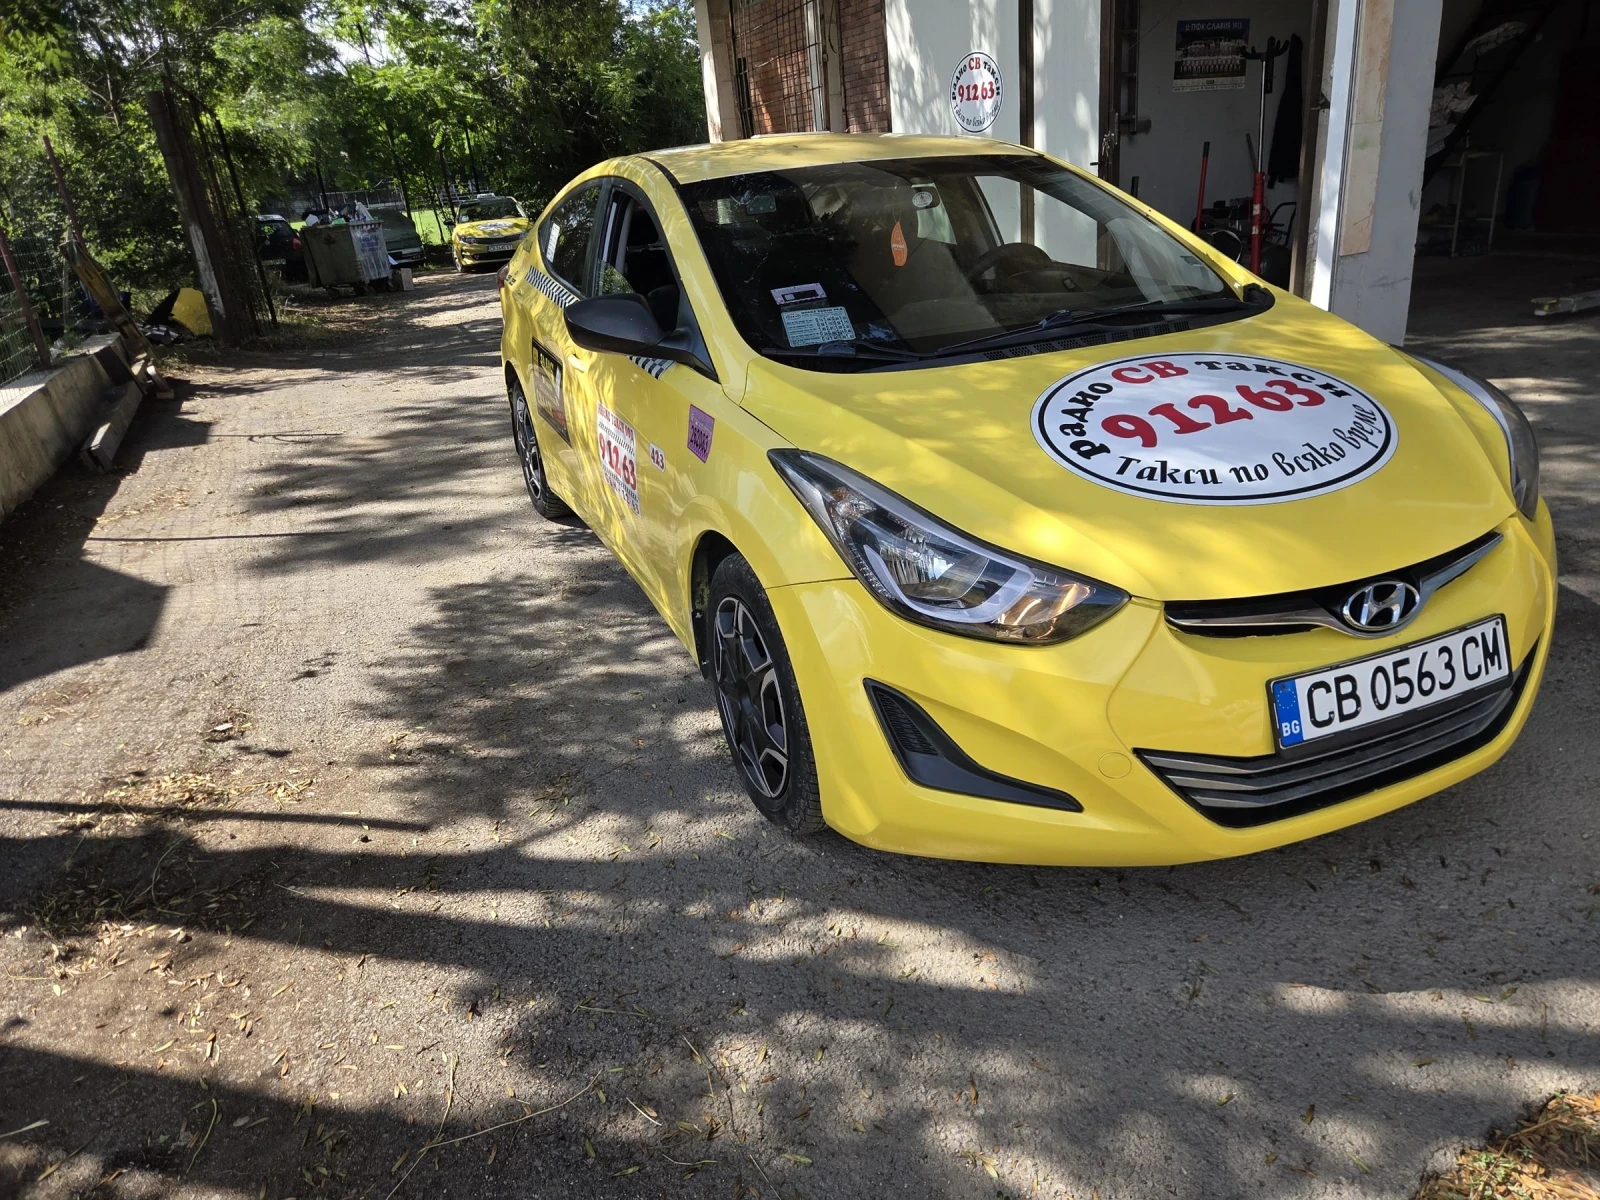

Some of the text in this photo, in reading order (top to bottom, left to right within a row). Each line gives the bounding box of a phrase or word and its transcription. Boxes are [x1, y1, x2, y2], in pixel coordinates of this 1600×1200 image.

[1111, 361, 1189, 384] СВ
[1194, 361, 1352, 398] такси
[651, 448, 665, 470] 423
[1115, 403, 1382, 485] Такси по всяко време
[1370, 646, 1456, 711] 0563
[1281, 720, 1301, 737] BG
